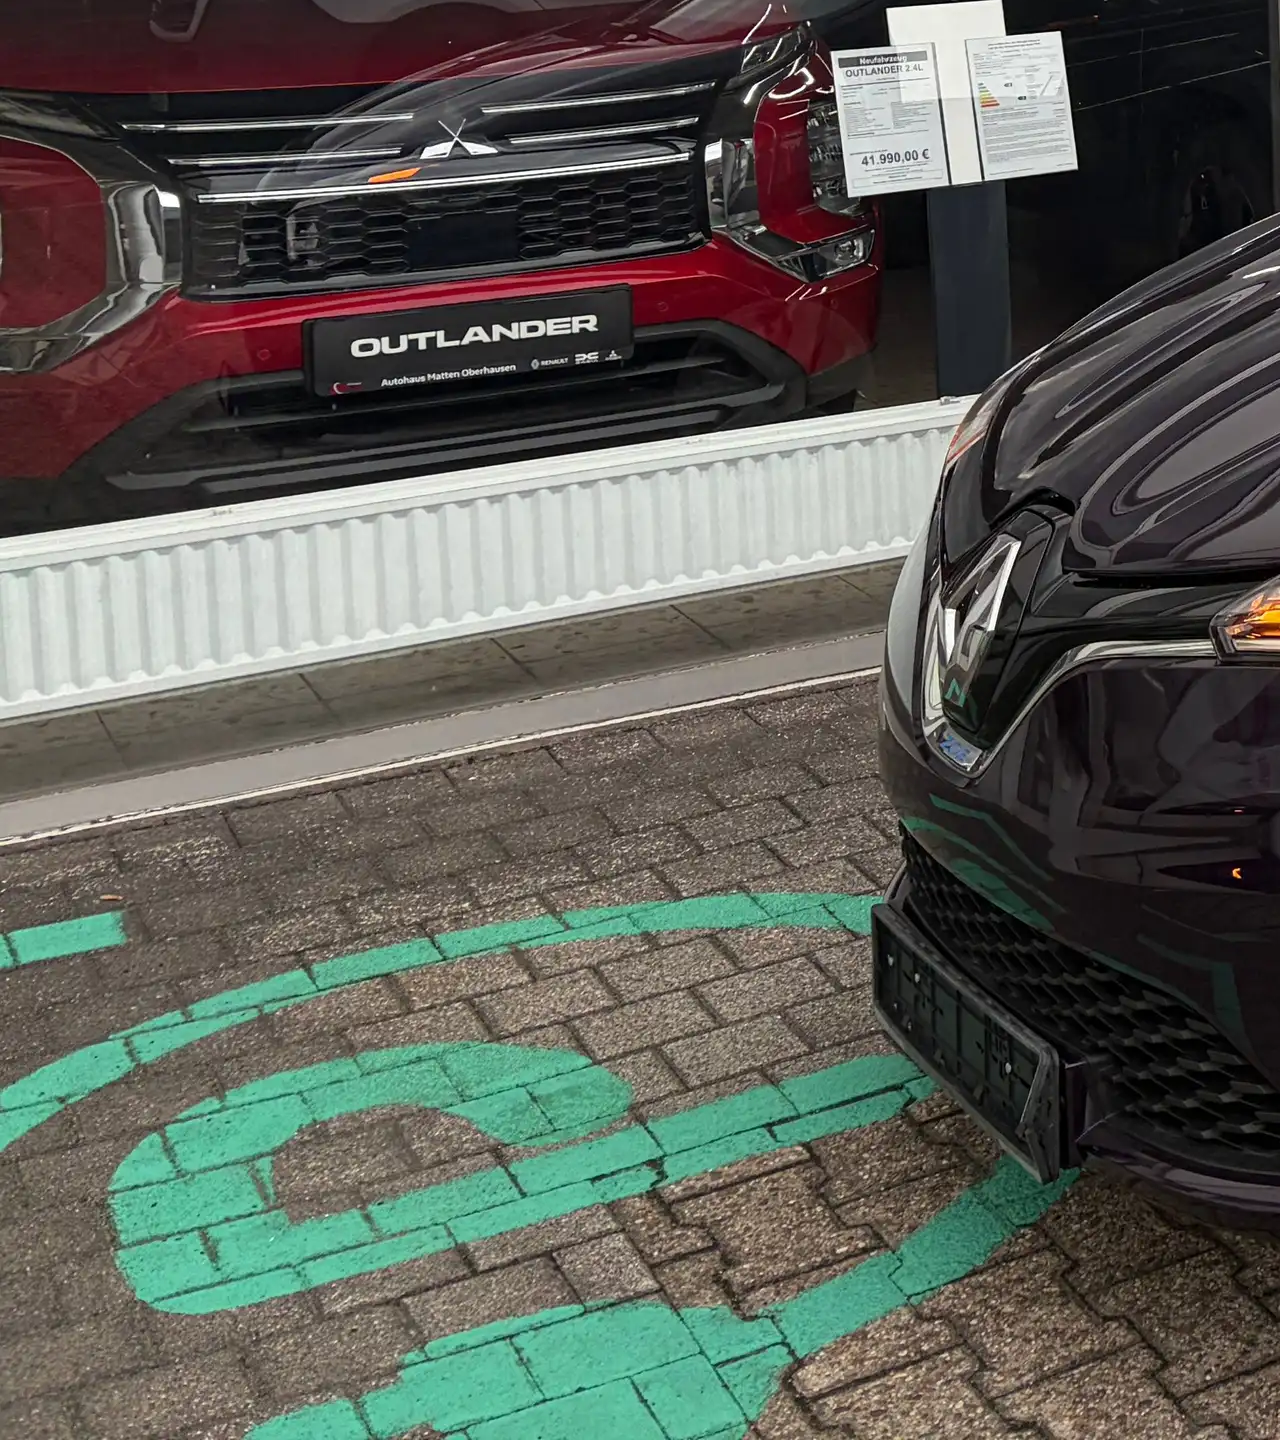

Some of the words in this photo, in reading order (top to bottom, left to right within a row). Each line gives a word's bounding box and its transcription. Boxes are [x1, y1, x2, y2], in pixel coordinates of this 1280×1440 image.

[859, 55, 908, 65] Neufahrzeug
[845, 65, 903, 78] OUTLANDER
[905, 64, 924, 73] 2.4L
[861, 150, 919, 166] 41.990,00
[922, 148, 930, 160] €
[350, 314, 599, 358] OUTLANDER
[381, 375, 426, 387] Autohaus
[427, 371, 460, 382] Matten
[461, 364, 517, 378] Oberhausen
